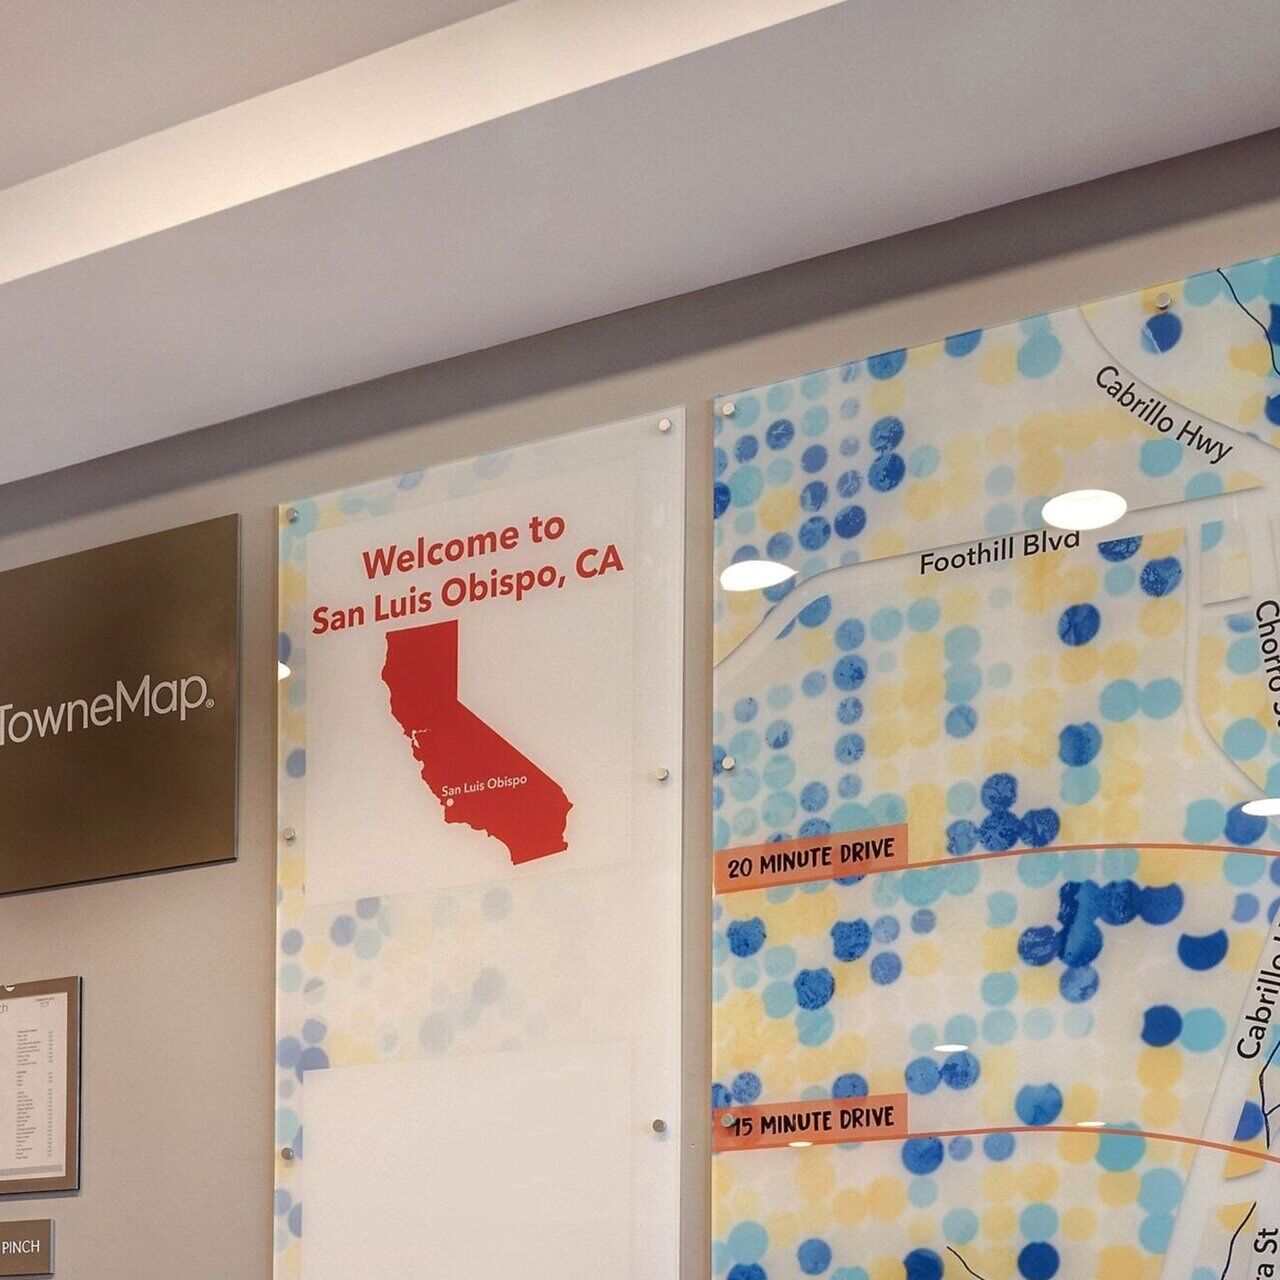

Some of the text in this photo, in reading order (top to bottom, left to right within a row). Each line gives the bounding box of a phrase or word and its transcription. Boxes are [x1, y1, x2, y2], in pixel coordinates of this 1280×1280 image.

[1096, 364, 1232, 465] Cabrillo Hwy
[362, 515, 565, 580] Welcome to
[920, 530, 1081, 575] Foothill Blvd
[312, 544, 624, 634] San Luis Obispo, CA
[441, 774, 528, 797] San Luis Obispo
[728, 838, 895, 878] 20 MINUTE DRIVE
[732, 1105, 895, 1137] 15 MINUTE DRIVE
[2, 1240, 40, 1254] PINCH
[1254, 1228, 1278, 1256] St
